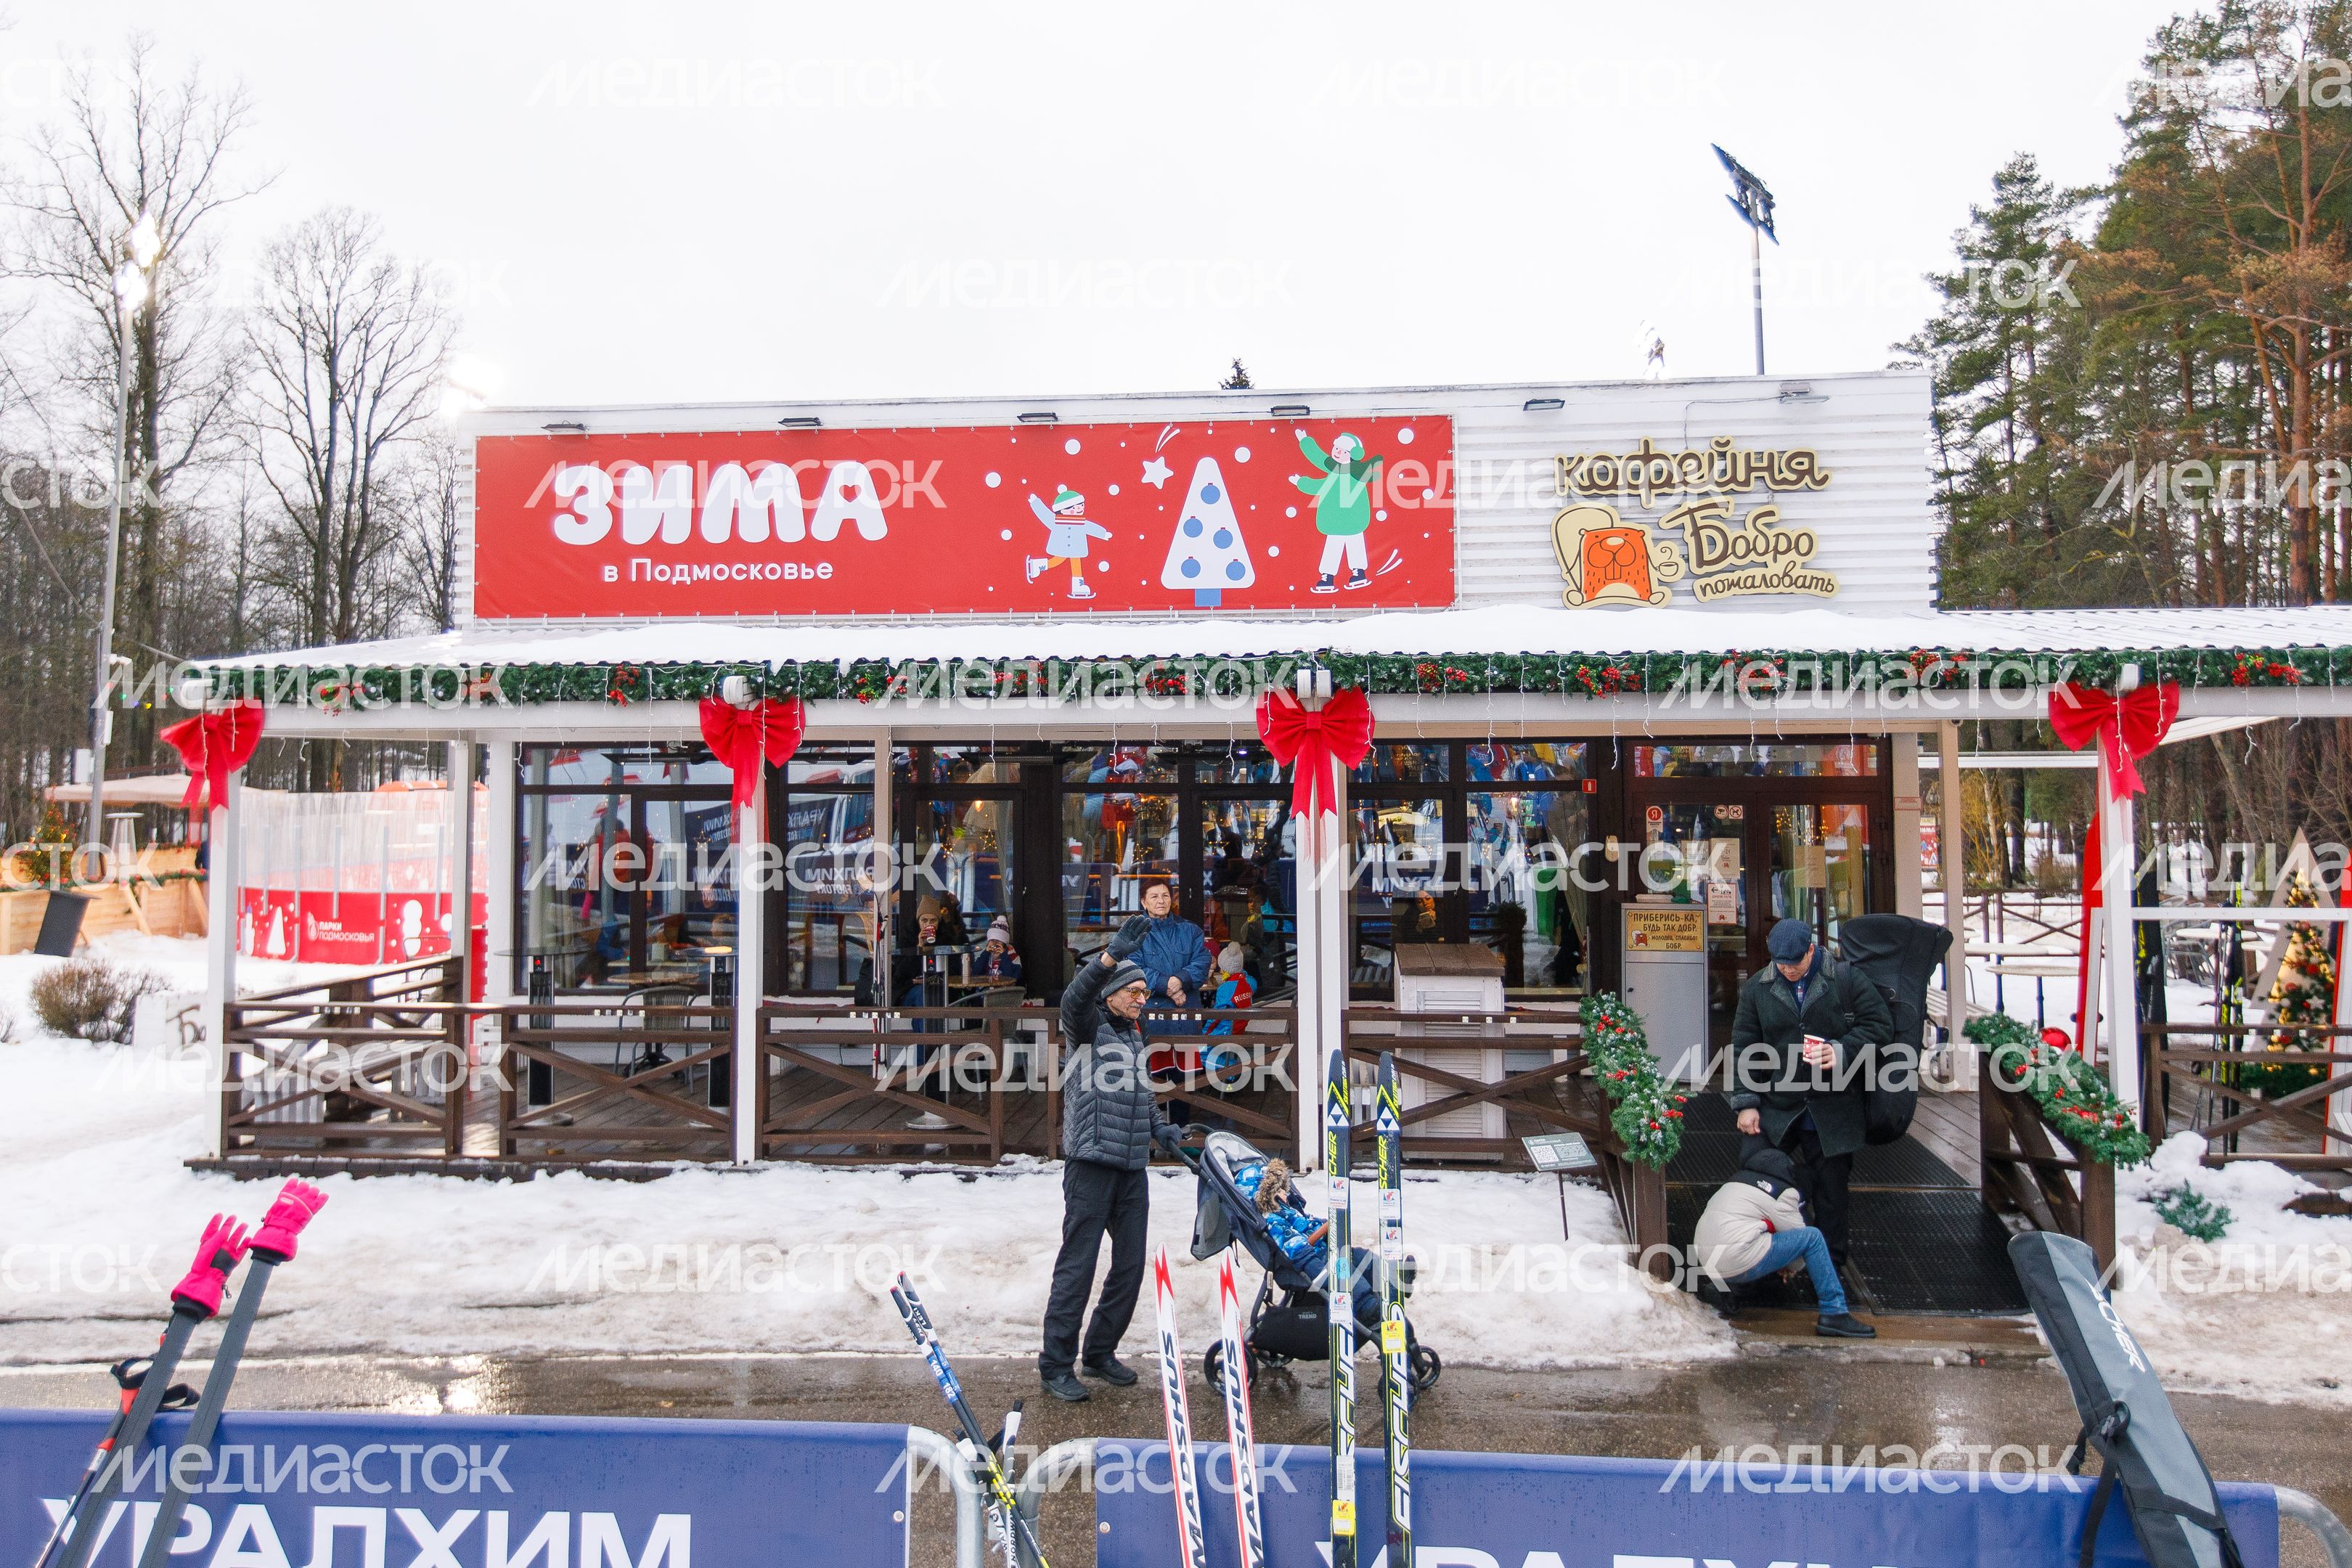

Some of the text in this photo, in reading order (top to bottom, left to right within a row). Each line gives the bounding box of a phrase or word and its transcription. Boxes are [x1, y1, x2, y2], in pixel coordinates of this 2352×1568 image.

[1557, 438, 1829, 504] кофейня
[554, 462, 889, 545] ЗИМА
[1661, 501, 1814, 568] Бобро
[603, 558, 834, 585] в Подмосковье
[1699, 562, 1836, 595] пожаловать
[319, 920, 342, 931] ПАРКИ
[1633, 913, 1697, 923] ПРИБЕРИСЬ-КА,
[319, 931, 375, 942] ПОДМОСКОВЬЯ
[1328, 1130, 1337, 1177] CHER
[931, 1359, 944, 1376] 140
[944, 1381, 956, 1399] 182
[1161, 1330, 1206, 1568] MADSHUS
